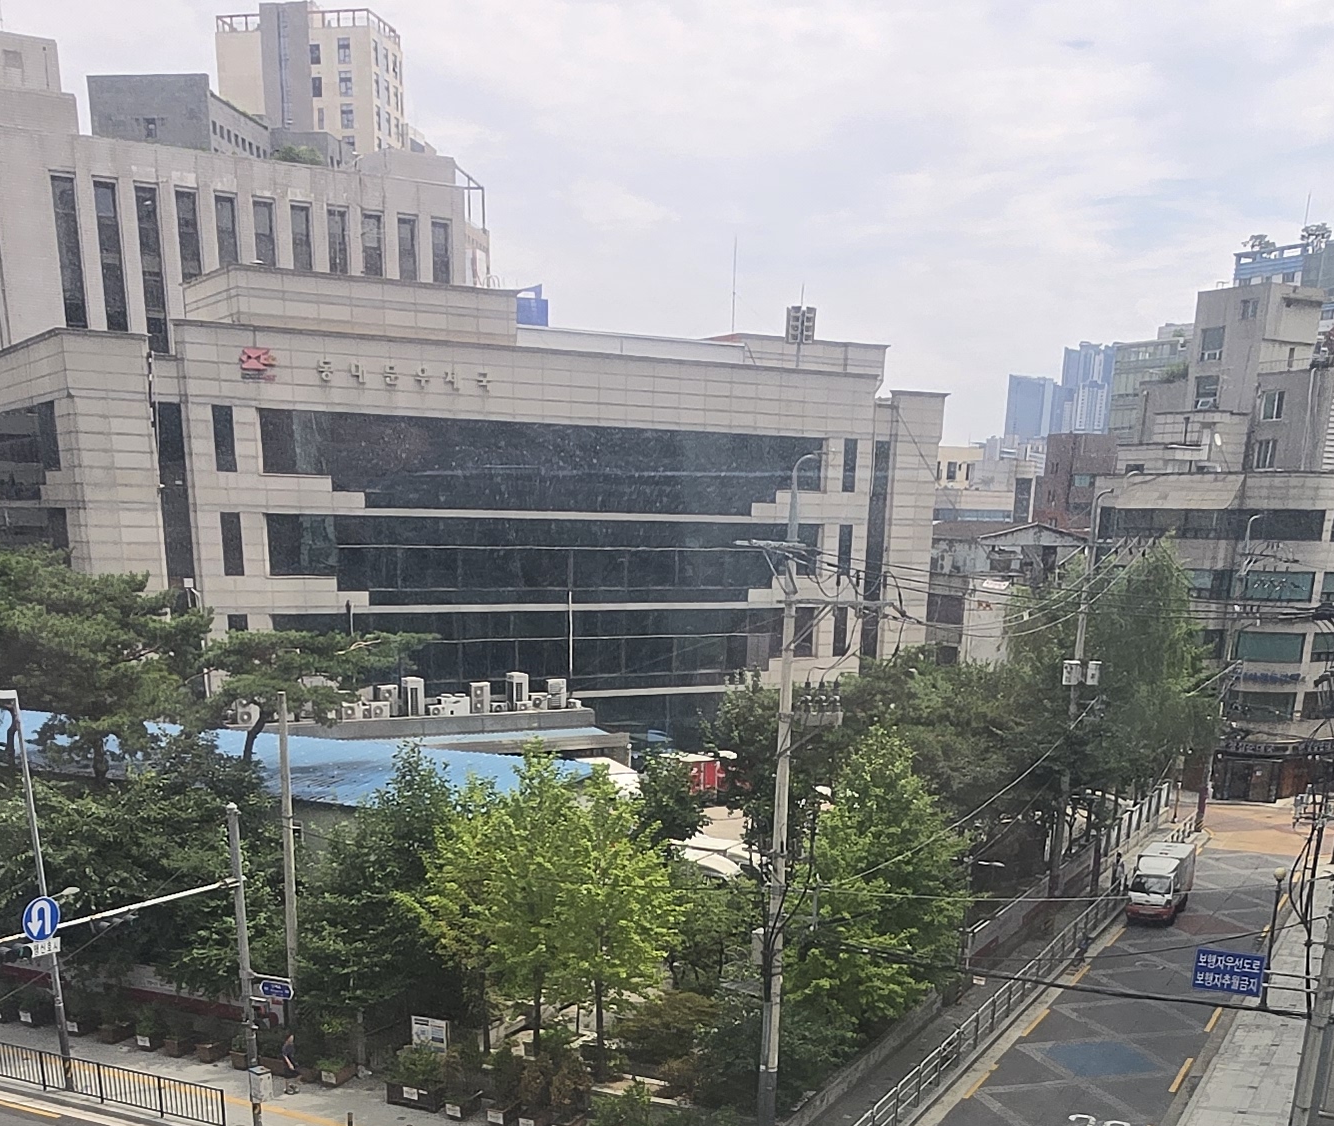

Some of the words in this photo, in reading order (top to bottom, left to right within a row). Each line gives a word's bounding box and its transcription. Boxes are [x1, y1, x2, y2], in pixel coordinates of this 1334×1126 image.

[317, 358, 491, 393] 동대문우체국
[1197, 953, 1261, 973] 보행자우선도로
[1195, 971, 1258, 992] 보행자추월금지
